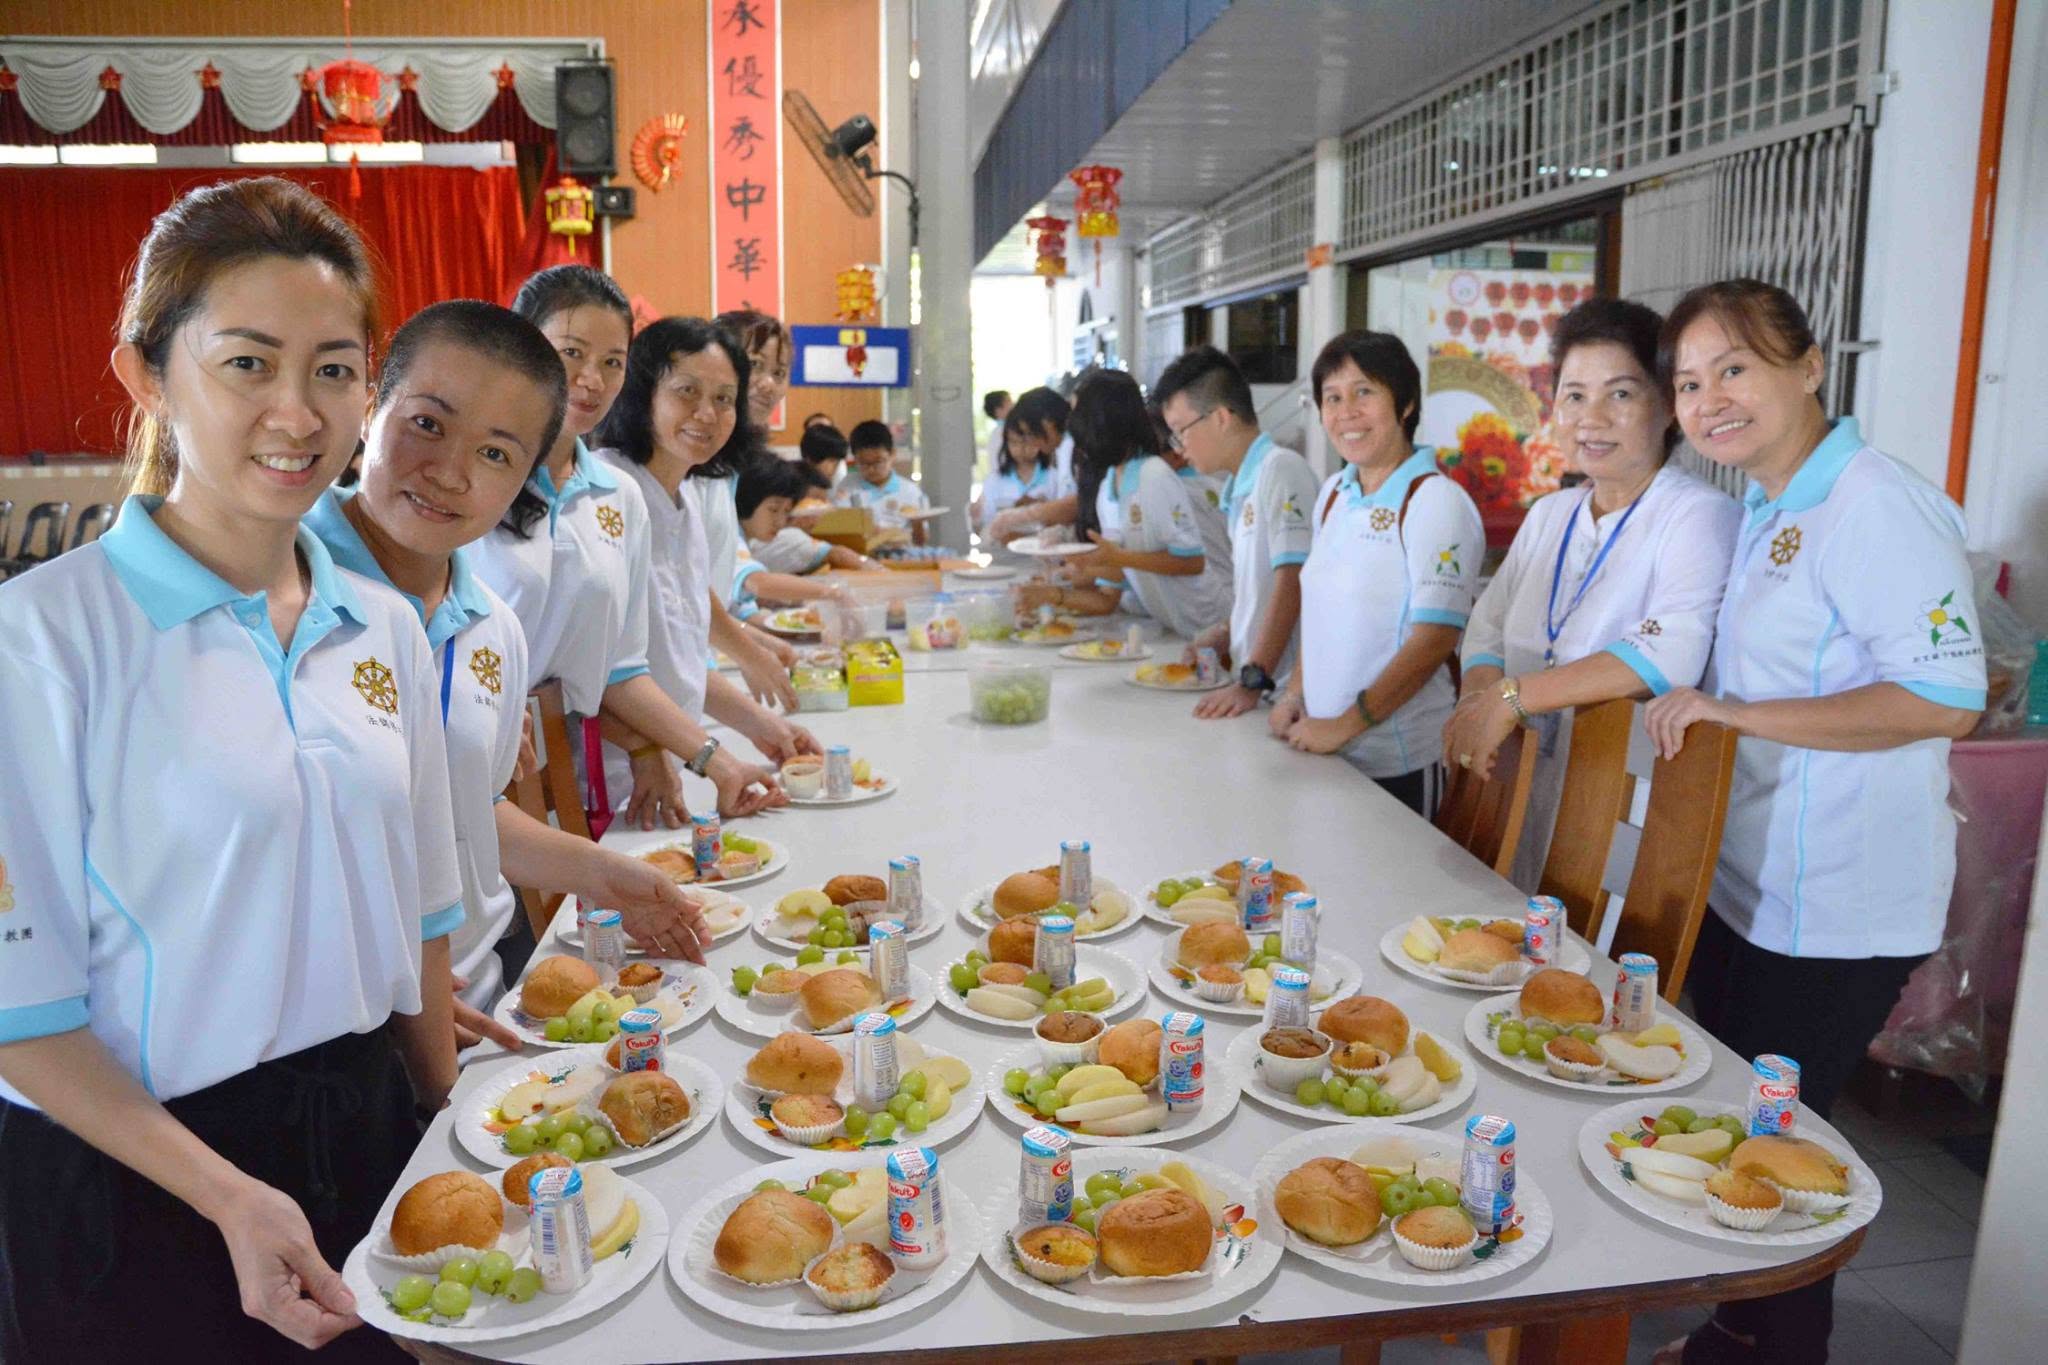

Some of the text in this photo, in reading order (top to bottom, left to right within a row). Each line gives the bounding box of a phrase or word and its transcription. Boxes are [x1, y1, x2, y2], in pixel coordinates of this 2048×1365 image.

[722, 0, 768, 311] 承優秀中華
